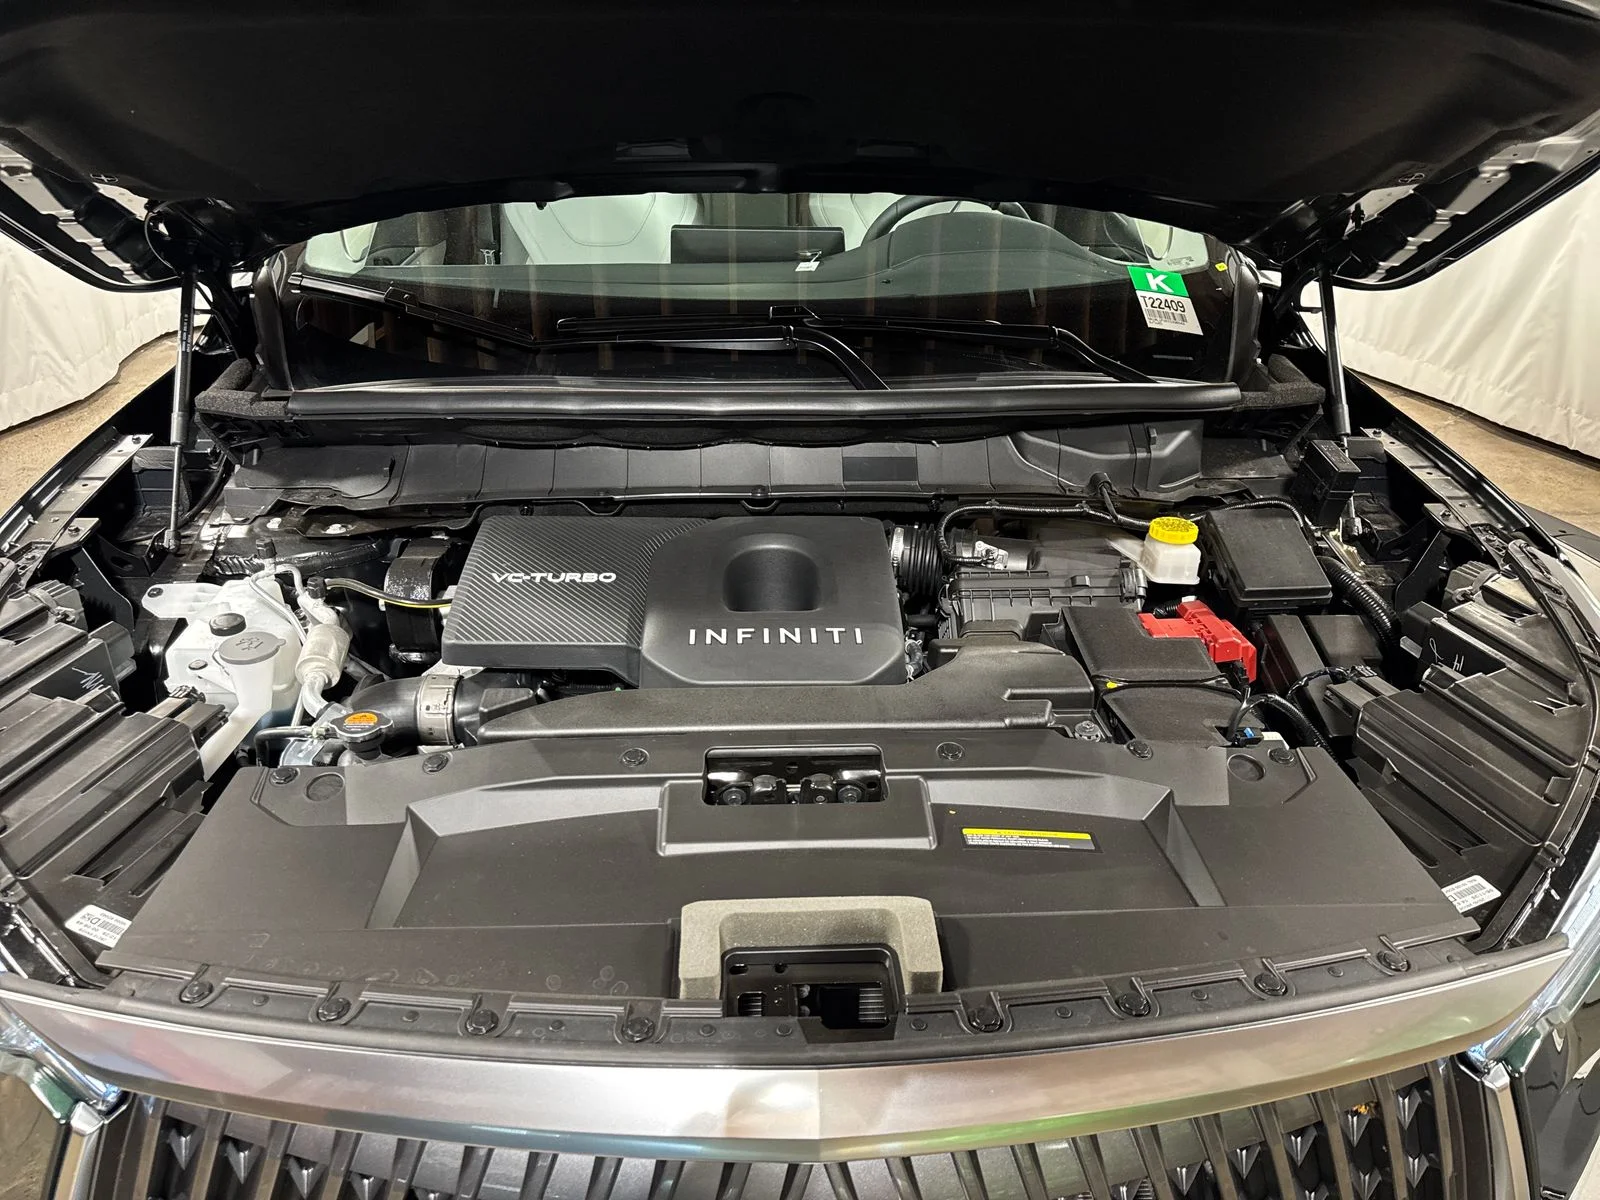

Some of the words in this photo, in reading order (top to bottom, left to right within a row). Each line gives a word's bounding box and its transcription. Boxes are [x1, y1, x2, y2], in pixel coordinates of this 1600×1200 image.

[1145, 272, 1174, 293] K
[1140, 296, 1186, 312] T22409
[491, 572, 617, 583] VC-TURBO
[689, 627, 863, 645] INFINITI
